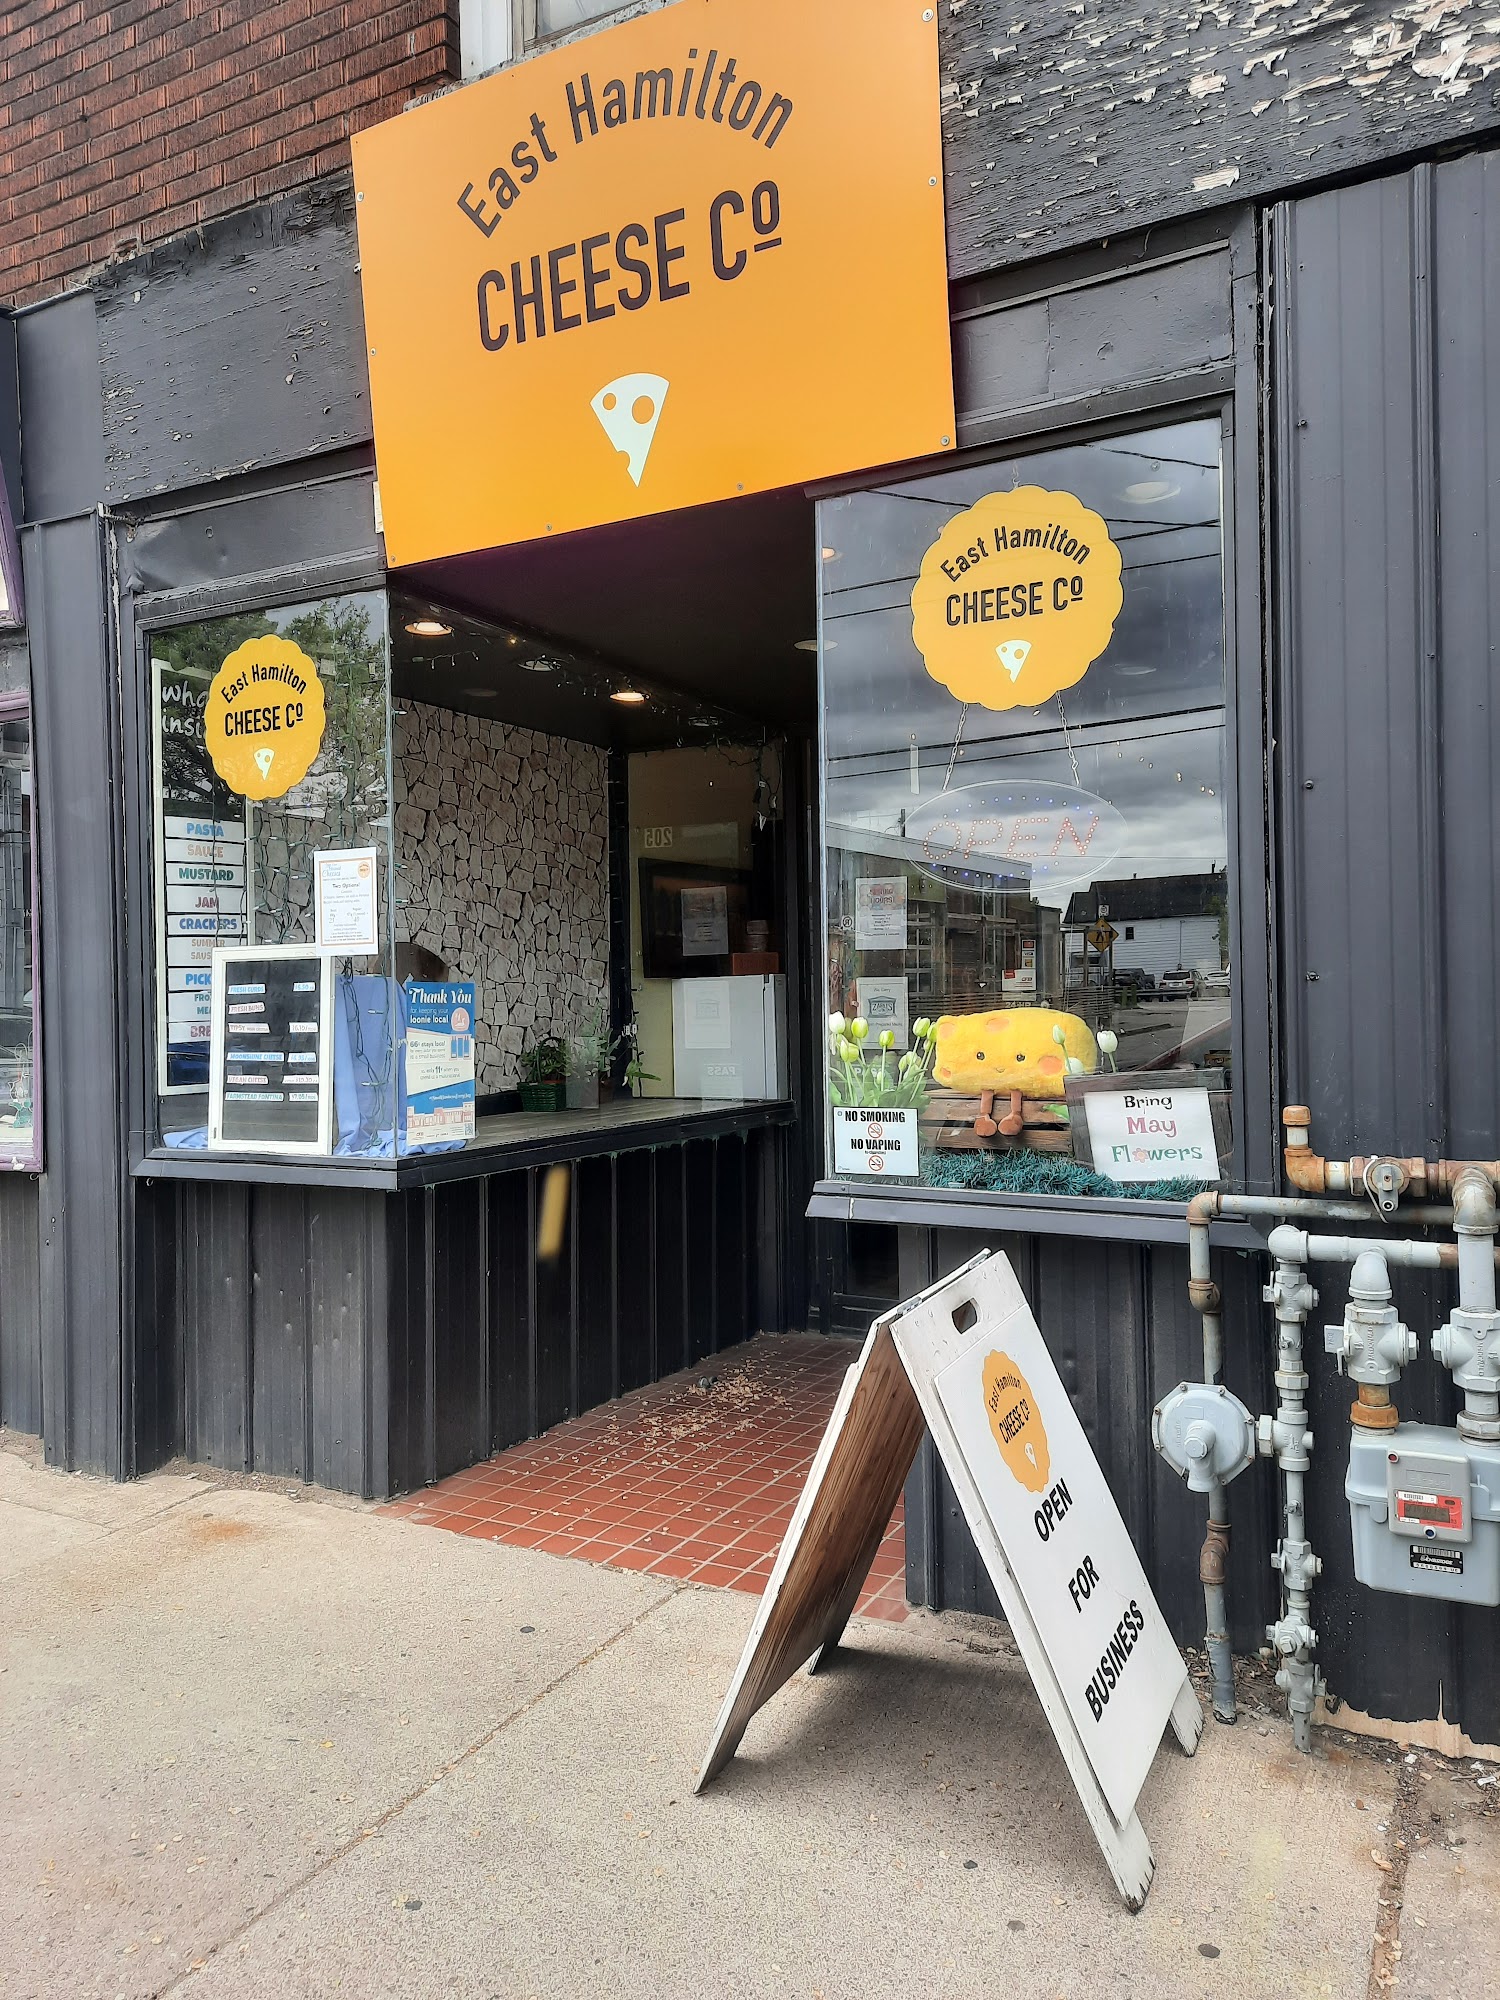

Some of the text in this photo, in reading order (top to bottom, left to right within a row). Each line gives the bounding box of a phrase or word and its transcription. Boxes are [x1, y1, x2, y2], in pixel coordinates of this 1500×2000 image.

[457, 48, 793, 238] East Hamilton
[477, 208, 690, 351] CHEESE
[940, 523, 1090, 582] East Hamilton
[946, 581, 1043, 626] CHEESE
[221, 664, 307, 704] East Hamilton
[224, 706, 281, 737] CHEESE
[187, 822, 224, 837] PASTA
[923, 816, 1100, 860] OPEN
[187, 844, 224, 858] SAUCE
[179, 867, 234, 881] MUSTARD
[195, 897, 219, 908] JAM
[179, 918, 237, 930] CRACKERS
[185, 974, 211, 985] PICK
[409, 987, 472, 1004] Thank You
[410, 1015, 448, 1024] loonie local
[419, 1007, 437, 1015] keeping
[1123, 1095, 1173, 1110] Bring
[845, 1110, 906, 1123] NO SMOKING
[1126, 1117, 1177, 1137] May
[851, 1138, 901, 1151] NO VAPING
[988, 1371, 1022, 1414] East Hamilton
[998, 1404, 1025, 1444] CHEESE
[1033, 1477, 1073, 1542] OPEN
[1068, 1555, 1100, 1613] FOR
[1084, 1600, 1145, 1722] BUSINESS
